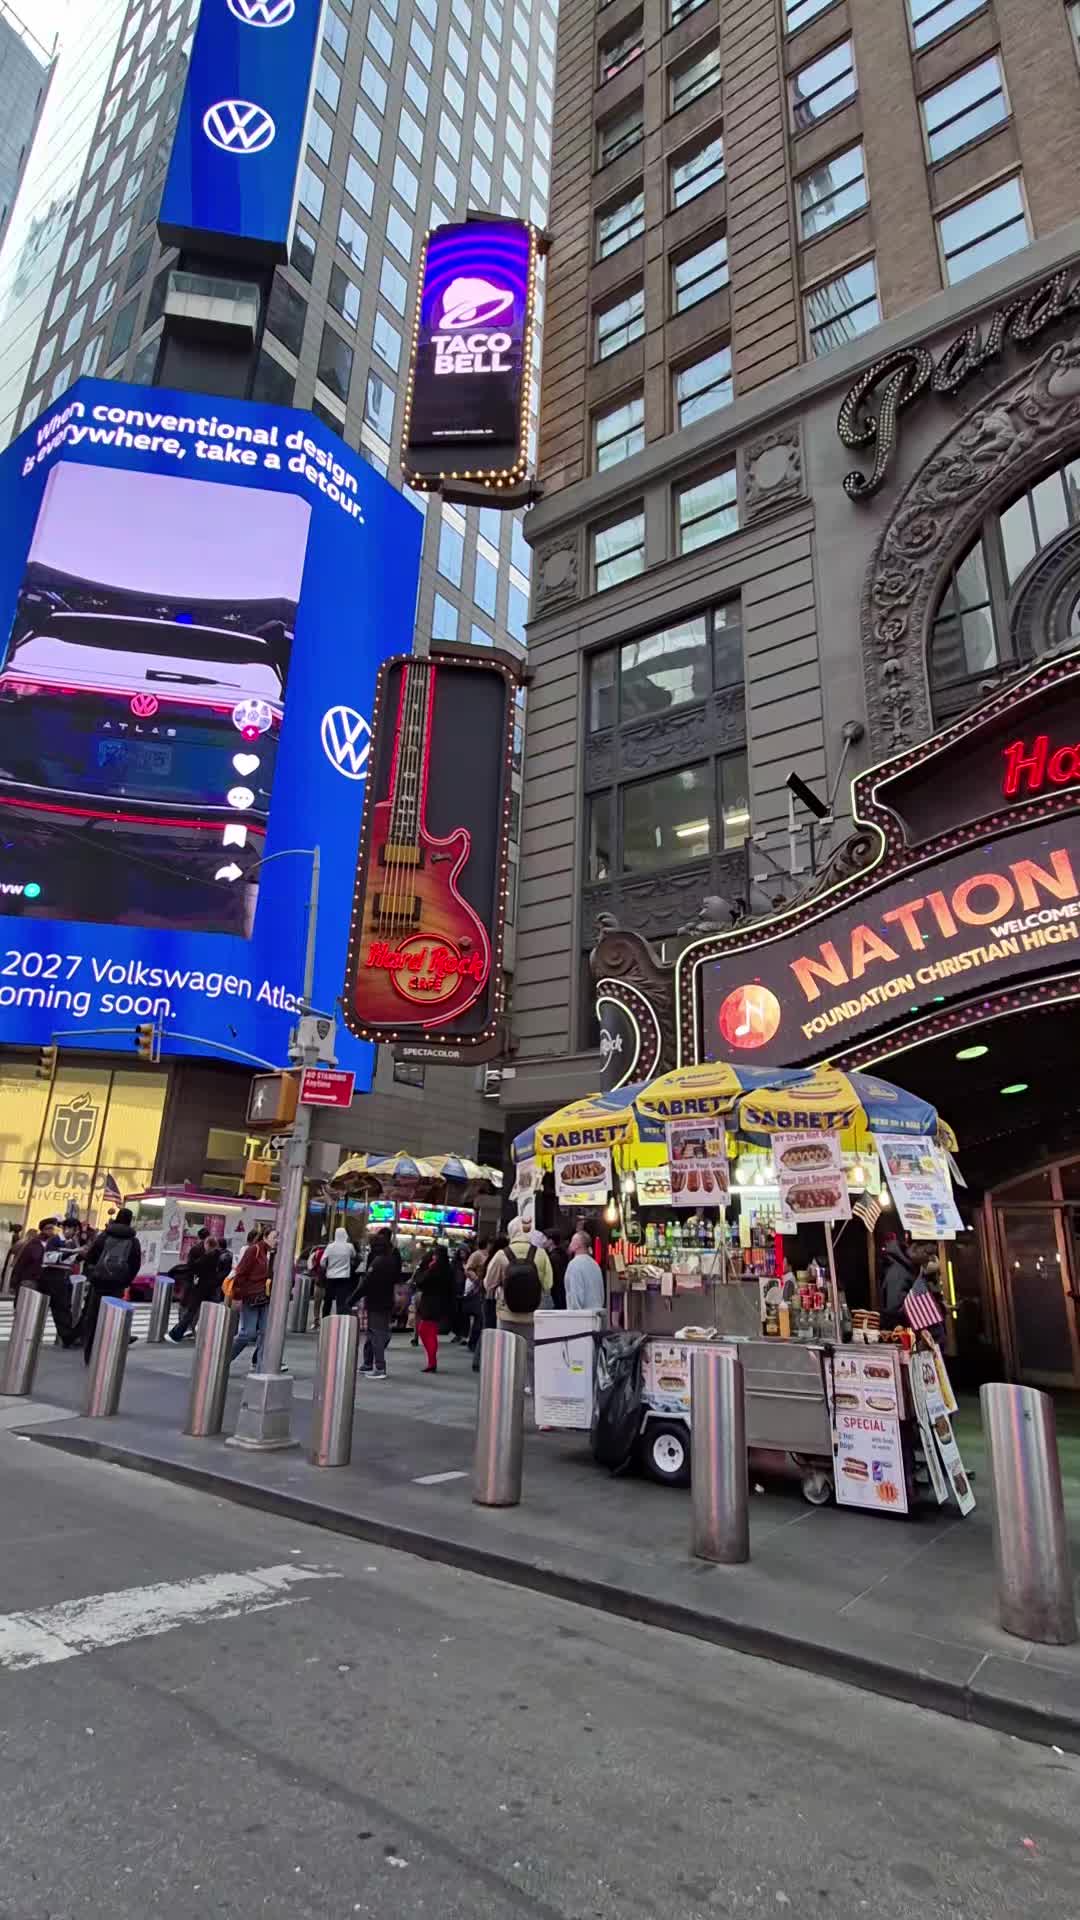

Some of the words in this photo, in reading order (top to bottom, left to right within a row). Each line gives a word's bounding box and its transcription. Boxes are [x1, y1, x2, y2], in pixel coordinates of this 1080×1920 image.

[431, 332, 512, 354] TACO
[434, 352, 512, 375] BELL
[37, 401, 85, 447] When
[92, 404, 279, 447] conventional
[285, 430, 358, 494] design
[22, 455, 36, 477] is
[36, 424, 187, 463] everywhere,
[195, 439, 258, 466] take
[263, 452, 281, 470] a
[288, 453, 366, 525] detour.
[103, 721, 177, 737] ATLAS
[788, 848, 1079, 1002] NATION
[990, 900, 1080, 938] WELCOME
[1, 950, 83, 980] 2027
[91, 957, 252, 998] Volkswagen
[365, 942, 426, 972] Hard
[429, 946, 484, 981] Rock
[801, 973, 916, 1040] FOUNDATION
[915, 937, 1021, 985] CHRISTIAN
[1020, 920, 1079, 951] HIGH
[100, 992, 177, 1018] soon.
[403, 1047, 460, 1058] SPECTACOLOR
[18, 1168, 107, 1190] TOURO
[843, 1417, 886, 1432] SPECIAL
